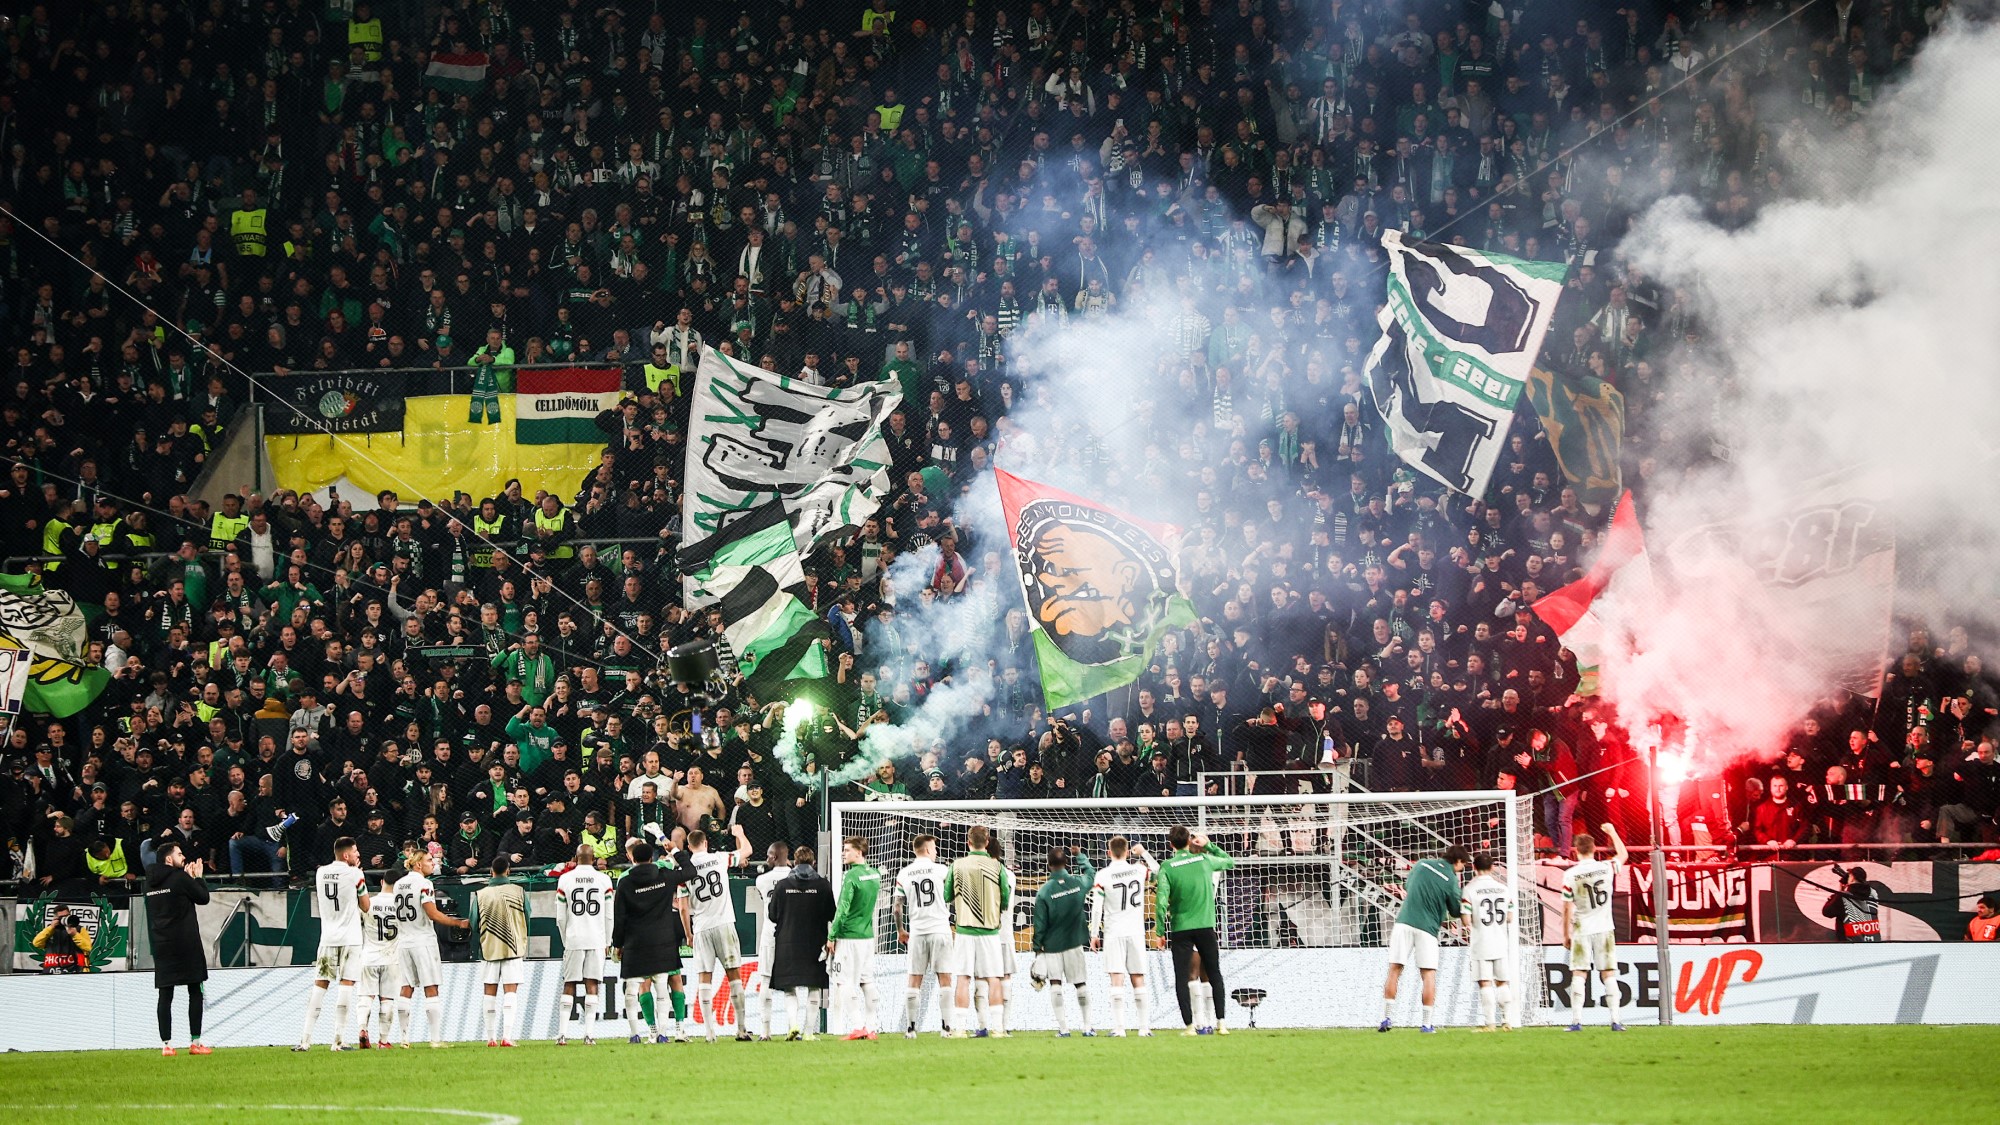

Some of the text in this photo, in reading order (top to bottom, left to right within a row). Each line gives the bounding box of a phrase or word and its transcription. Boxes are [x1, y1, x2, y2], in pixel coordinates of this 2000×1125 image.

[535, 396, 600, 412] CELLDÖMÖLK
[324, 883, 340, 911] 4
[691, 870, 723, 903] 28
[911, 878, 935, 908] 19
[1112, 879, 1142, 912] 72
[1583, 880, 1608, 909] 16
[1632, 866, 1747, 911] YOUNG
[46, 907, 99, 920] ETERN
[395, 893, 417, 922] 25
[571, 887, 601, 916] 66
[373, 914, 398, 941] 15
[1545, 961, 1660, 1008] RISE
